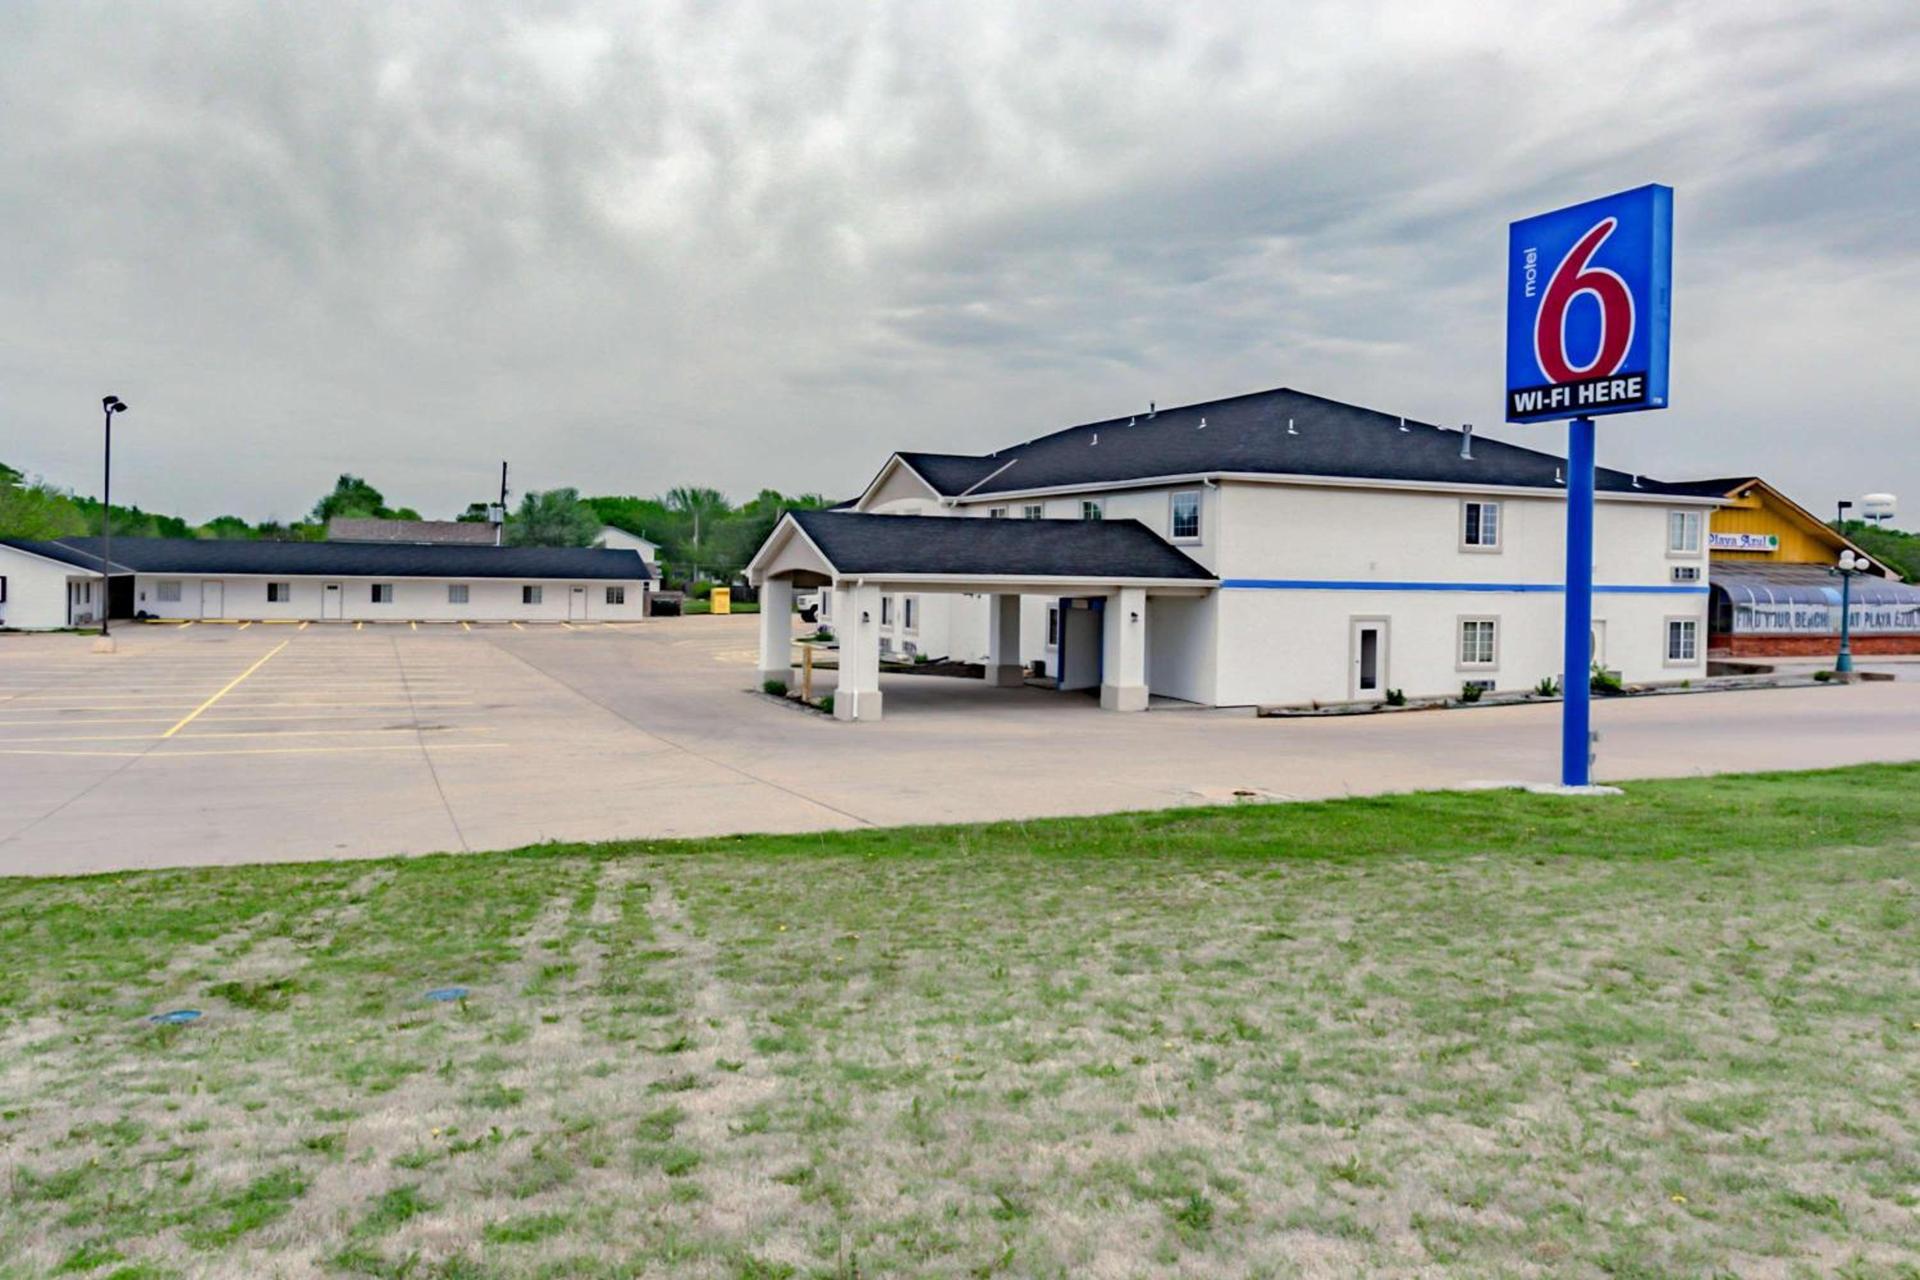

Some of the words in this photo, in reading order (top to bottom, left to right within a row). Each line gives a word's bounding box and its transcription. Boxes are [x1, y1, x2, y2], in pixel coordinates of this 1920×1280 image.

[1523, 247, 1537, 298] motel
[1533, 215, 1636, 385] 6
[1513, 386, 1570, 412] WI-FI
[1578, 376, 1643, 405] HERE
[1849, 611, 1860, 628] AT
[1864, 611, 1891, 628] PLAYA
